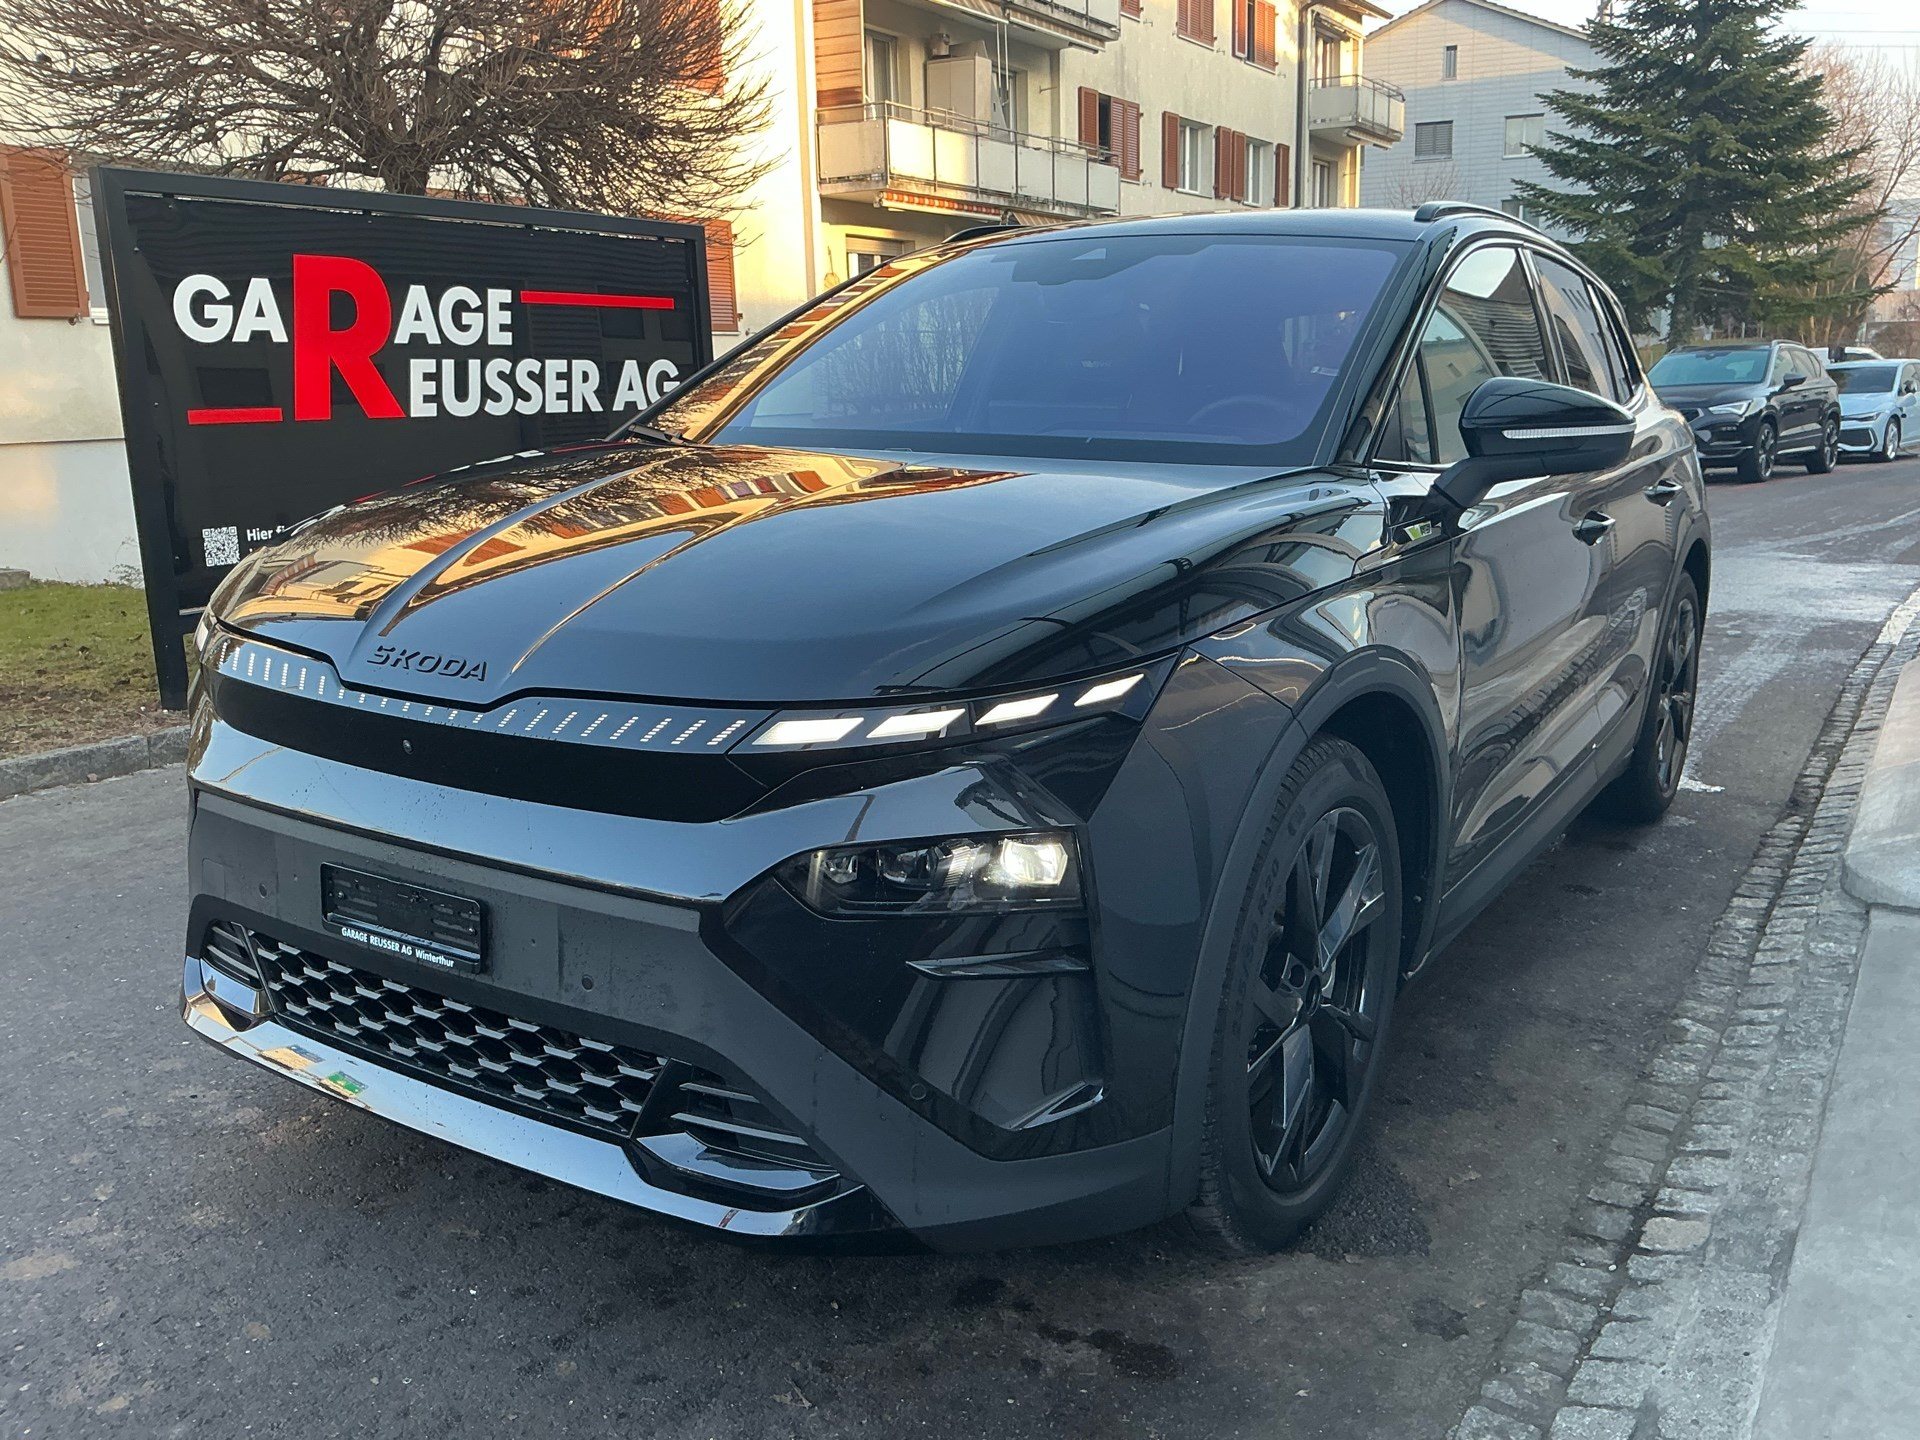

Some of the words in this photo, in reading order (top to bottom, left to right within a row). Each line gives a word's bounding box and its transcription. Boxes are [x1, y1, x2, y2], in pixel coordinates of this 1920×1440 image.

[172, 253, 514, 421] GARAGE
[612, 359, 681, 411] AG
[246, 527, 273, 541] Hier
[341, 927, 368, 942] GARAGE
[370, 935, 400, 952] REUSSER
[401, 944, 413, 955] AG
[415, 948, 455, 967] Winterthur
